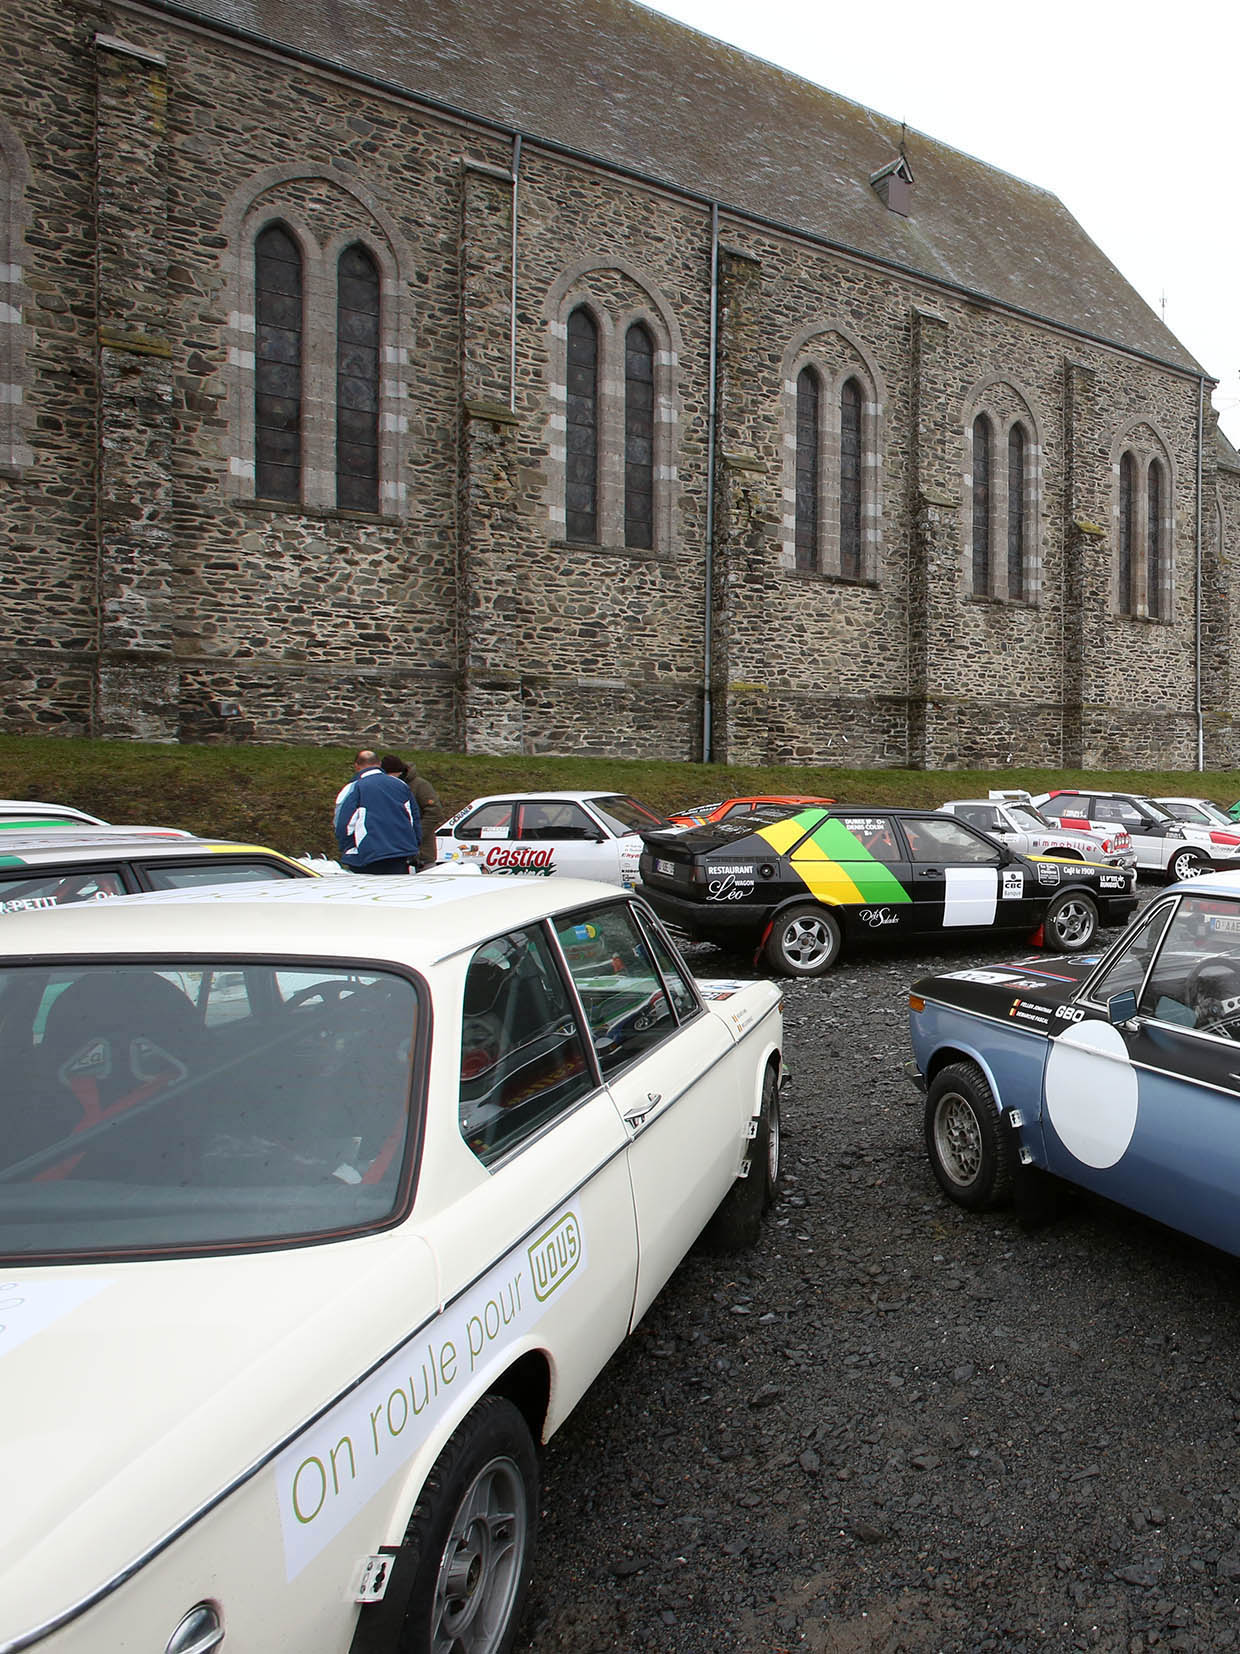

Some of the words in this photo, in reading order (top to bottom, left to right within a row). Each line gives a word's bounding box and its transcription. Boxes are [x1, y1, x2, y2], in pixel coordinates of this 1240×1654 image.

[1038, 840, 1098, 853] immobilier
[486, 846, 555, 867] Castrol
[708, 865, 754, 874] RESTAURANT
[1081, 867, 1095, 875] 1900
[706, 875, 755, 901] Léo
[1004, 889, 1021, 897] Banque
[1055, 1005, 1085, 1022] GBO
[292, 1435, 356, 1524] On
[369, 1341, 458, 1456] roule
[466, 1271, 522, 1373] pour
